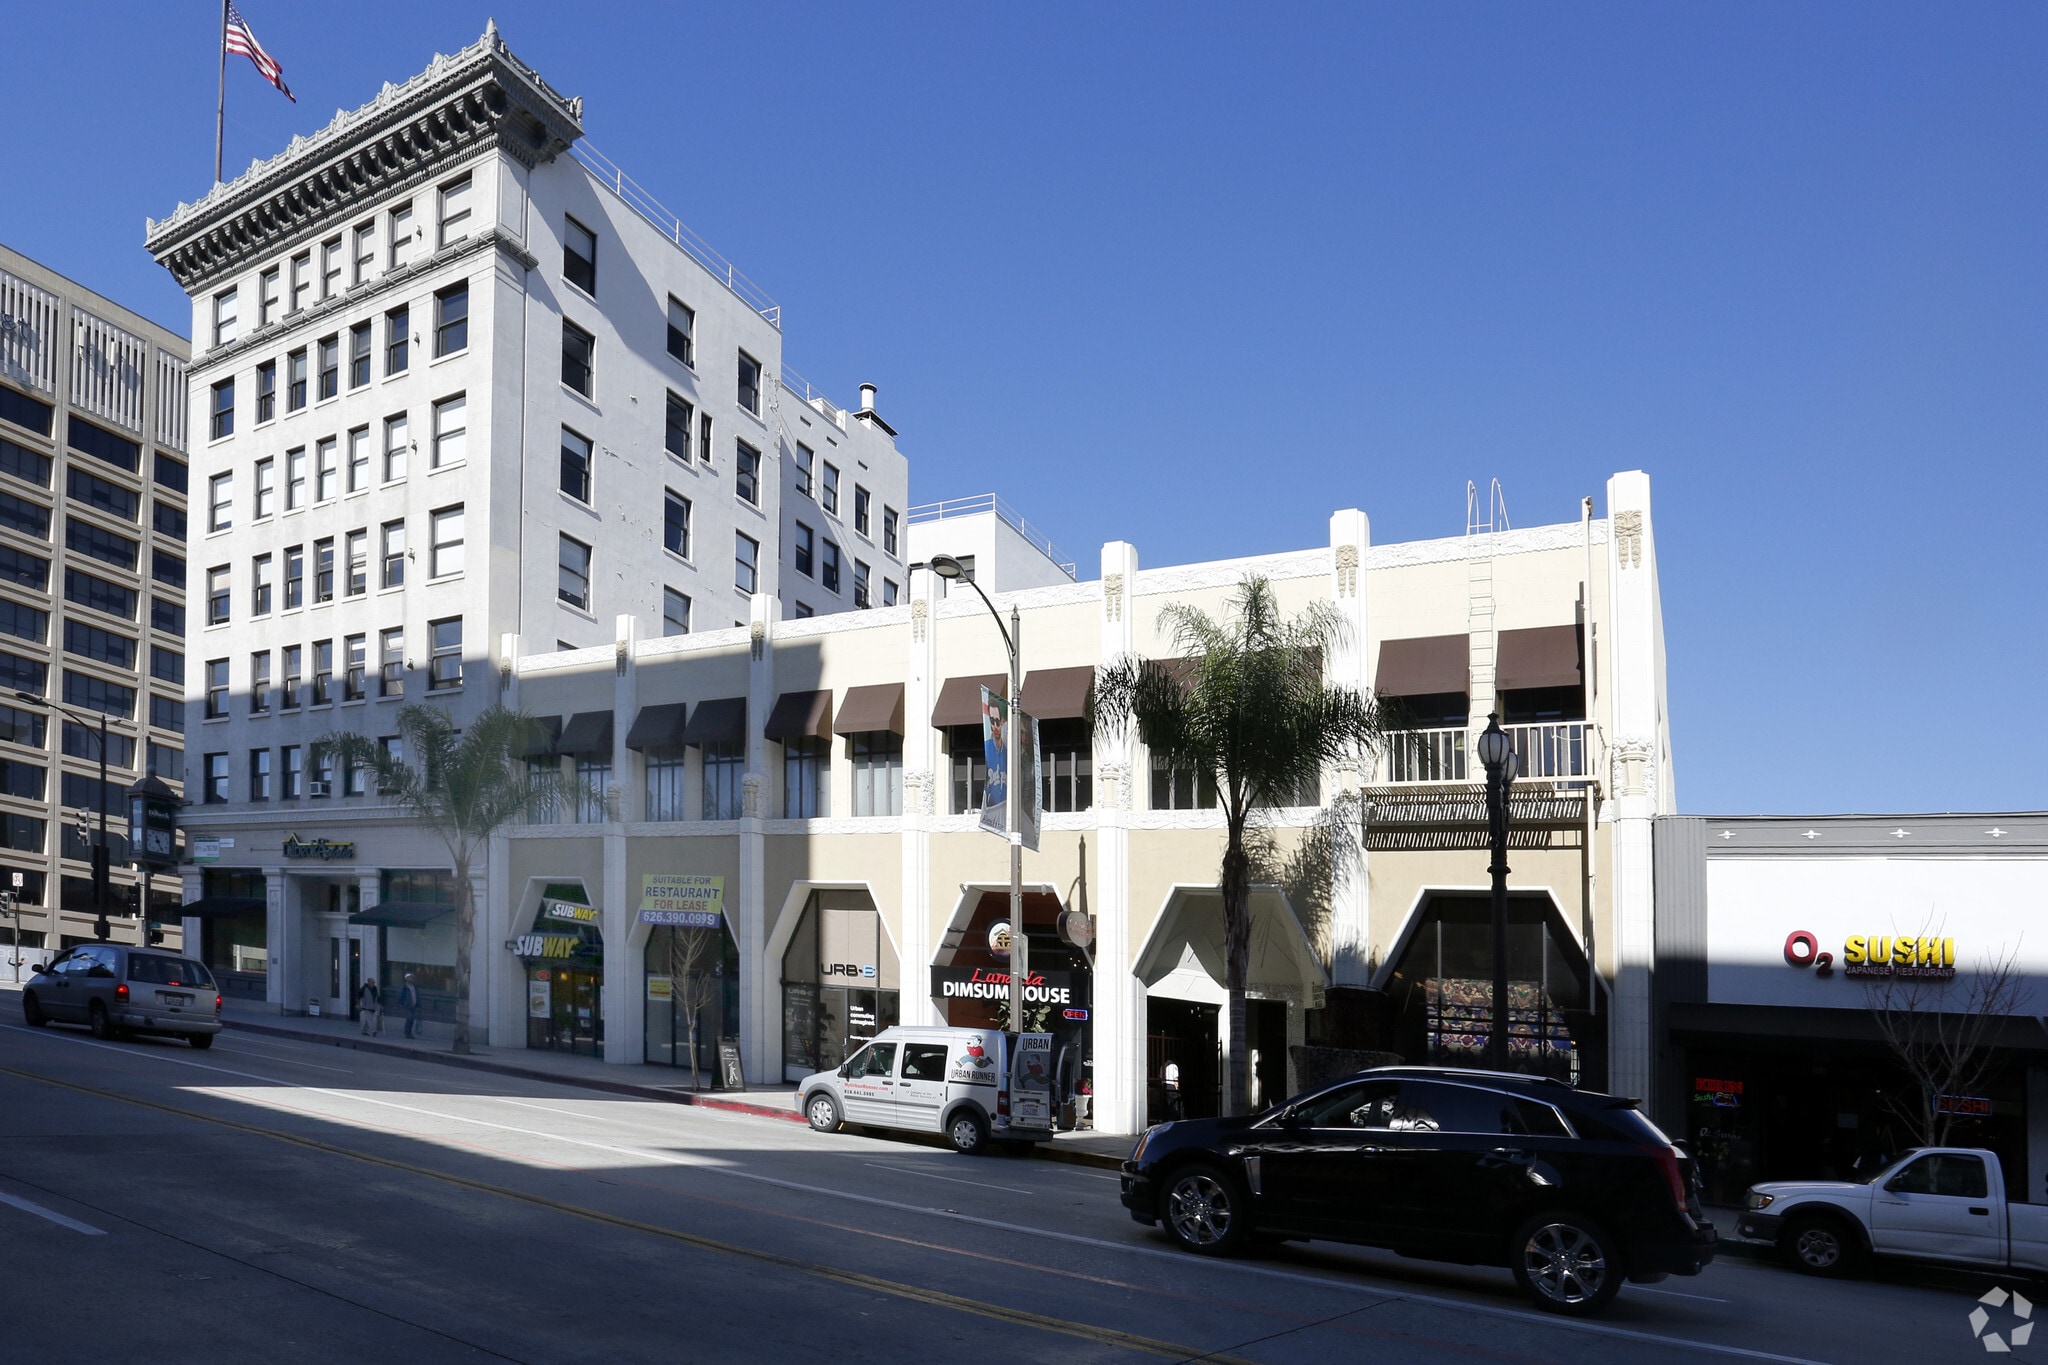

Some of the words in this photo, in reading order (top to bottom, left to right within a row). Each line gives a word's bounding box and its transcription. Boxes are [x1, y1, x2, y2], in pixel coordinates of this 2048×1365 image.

[652, 876, 692, 884] SUITABLE
[694, 877, 711, 885] FOR
[645, 886, 720, 899] RESTAURANT
[552, 904, 598, 920] SUBWAY
[653, 900, 673, 910] FOR
[676, 901, 708, 911] LEASE
[643, 911, 715, 925] 626.390.0999
[514, 936, 579, 958] SUBWAY
[1844, 935, 1955, 966] SUSHI
[1846, 966, 1890, 976] JAPANESE
[1896, 967, 1955, 977] RESTAURANT
[1063, 1010, 1085, 1019] OPEN
[1022, 1038, 1050, 1050] URBAN
[951, 1069, 970, 1079] URBAN
[972, 1071, 996, 1083] RUNNER
[1695, 1077, 1743, 1095] KIRIN
